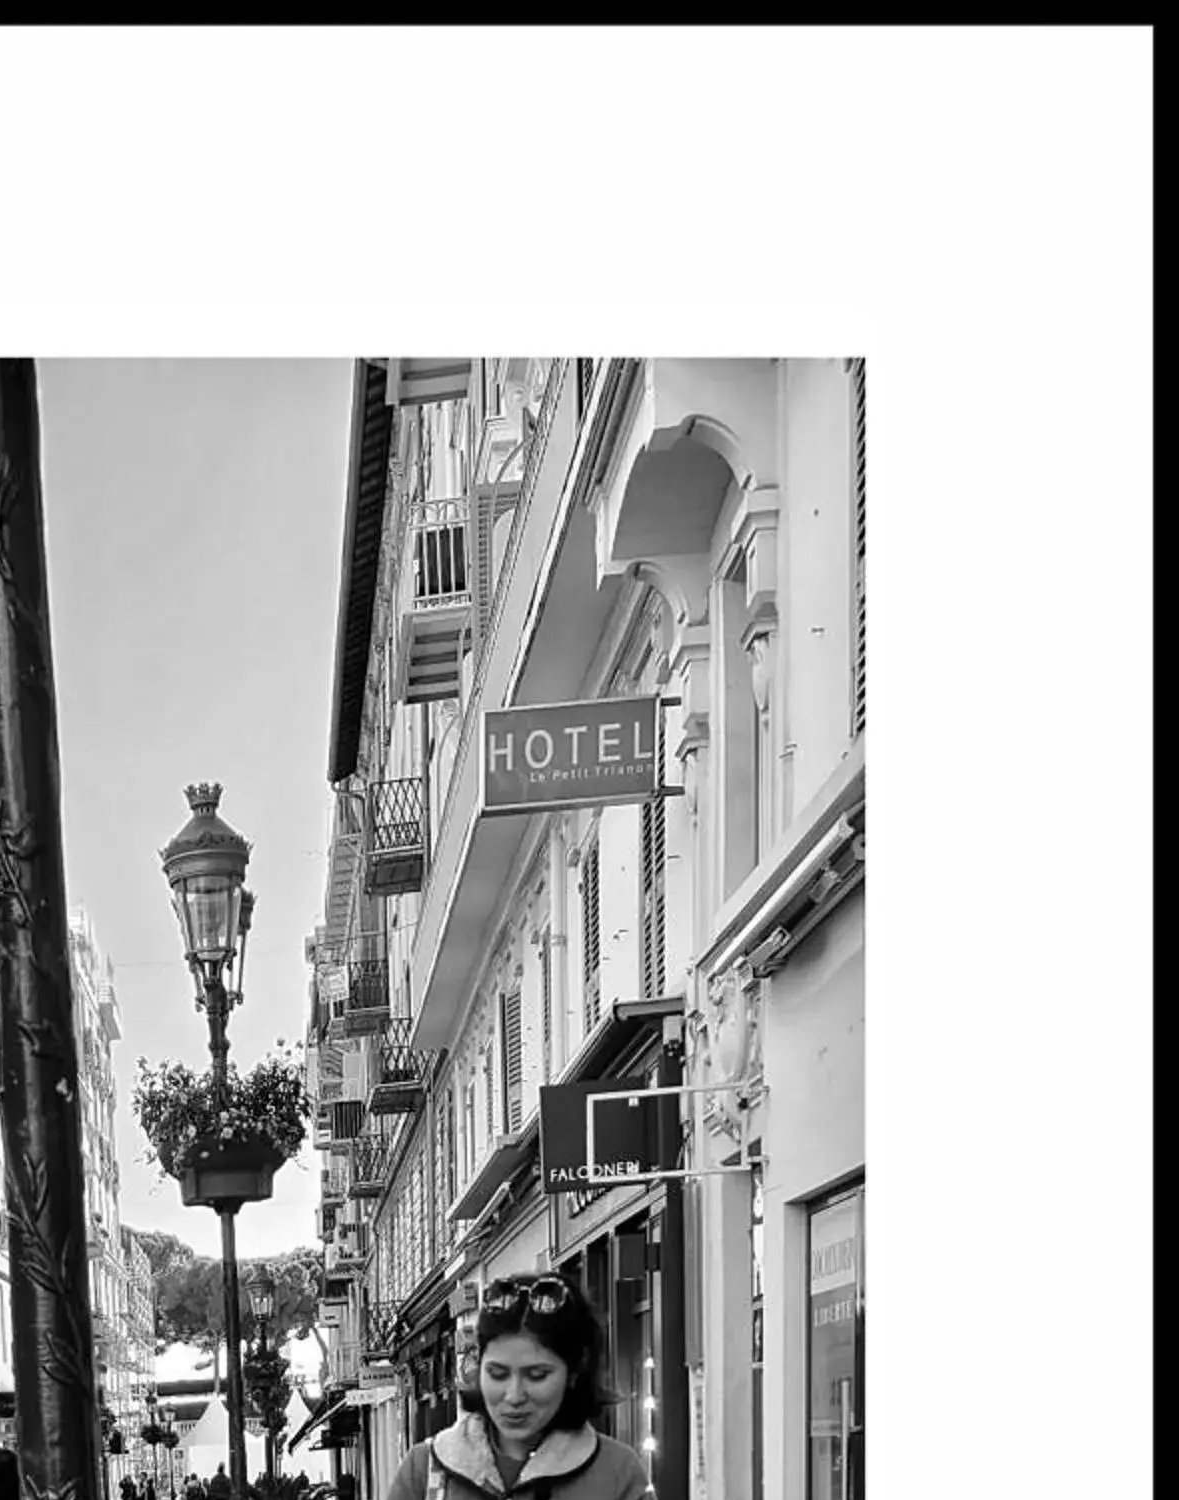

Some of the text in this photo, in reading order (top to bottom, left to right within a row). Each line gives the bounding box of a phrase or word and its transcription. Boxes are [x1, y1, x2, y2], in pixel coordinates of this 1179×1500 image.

[489, 721, 653, 773] HOTEL
[530, 771, 546, 783] Le
[552, 768, 588, 781] Petit
[550, 1160, 640, 1183] FALCONERI
